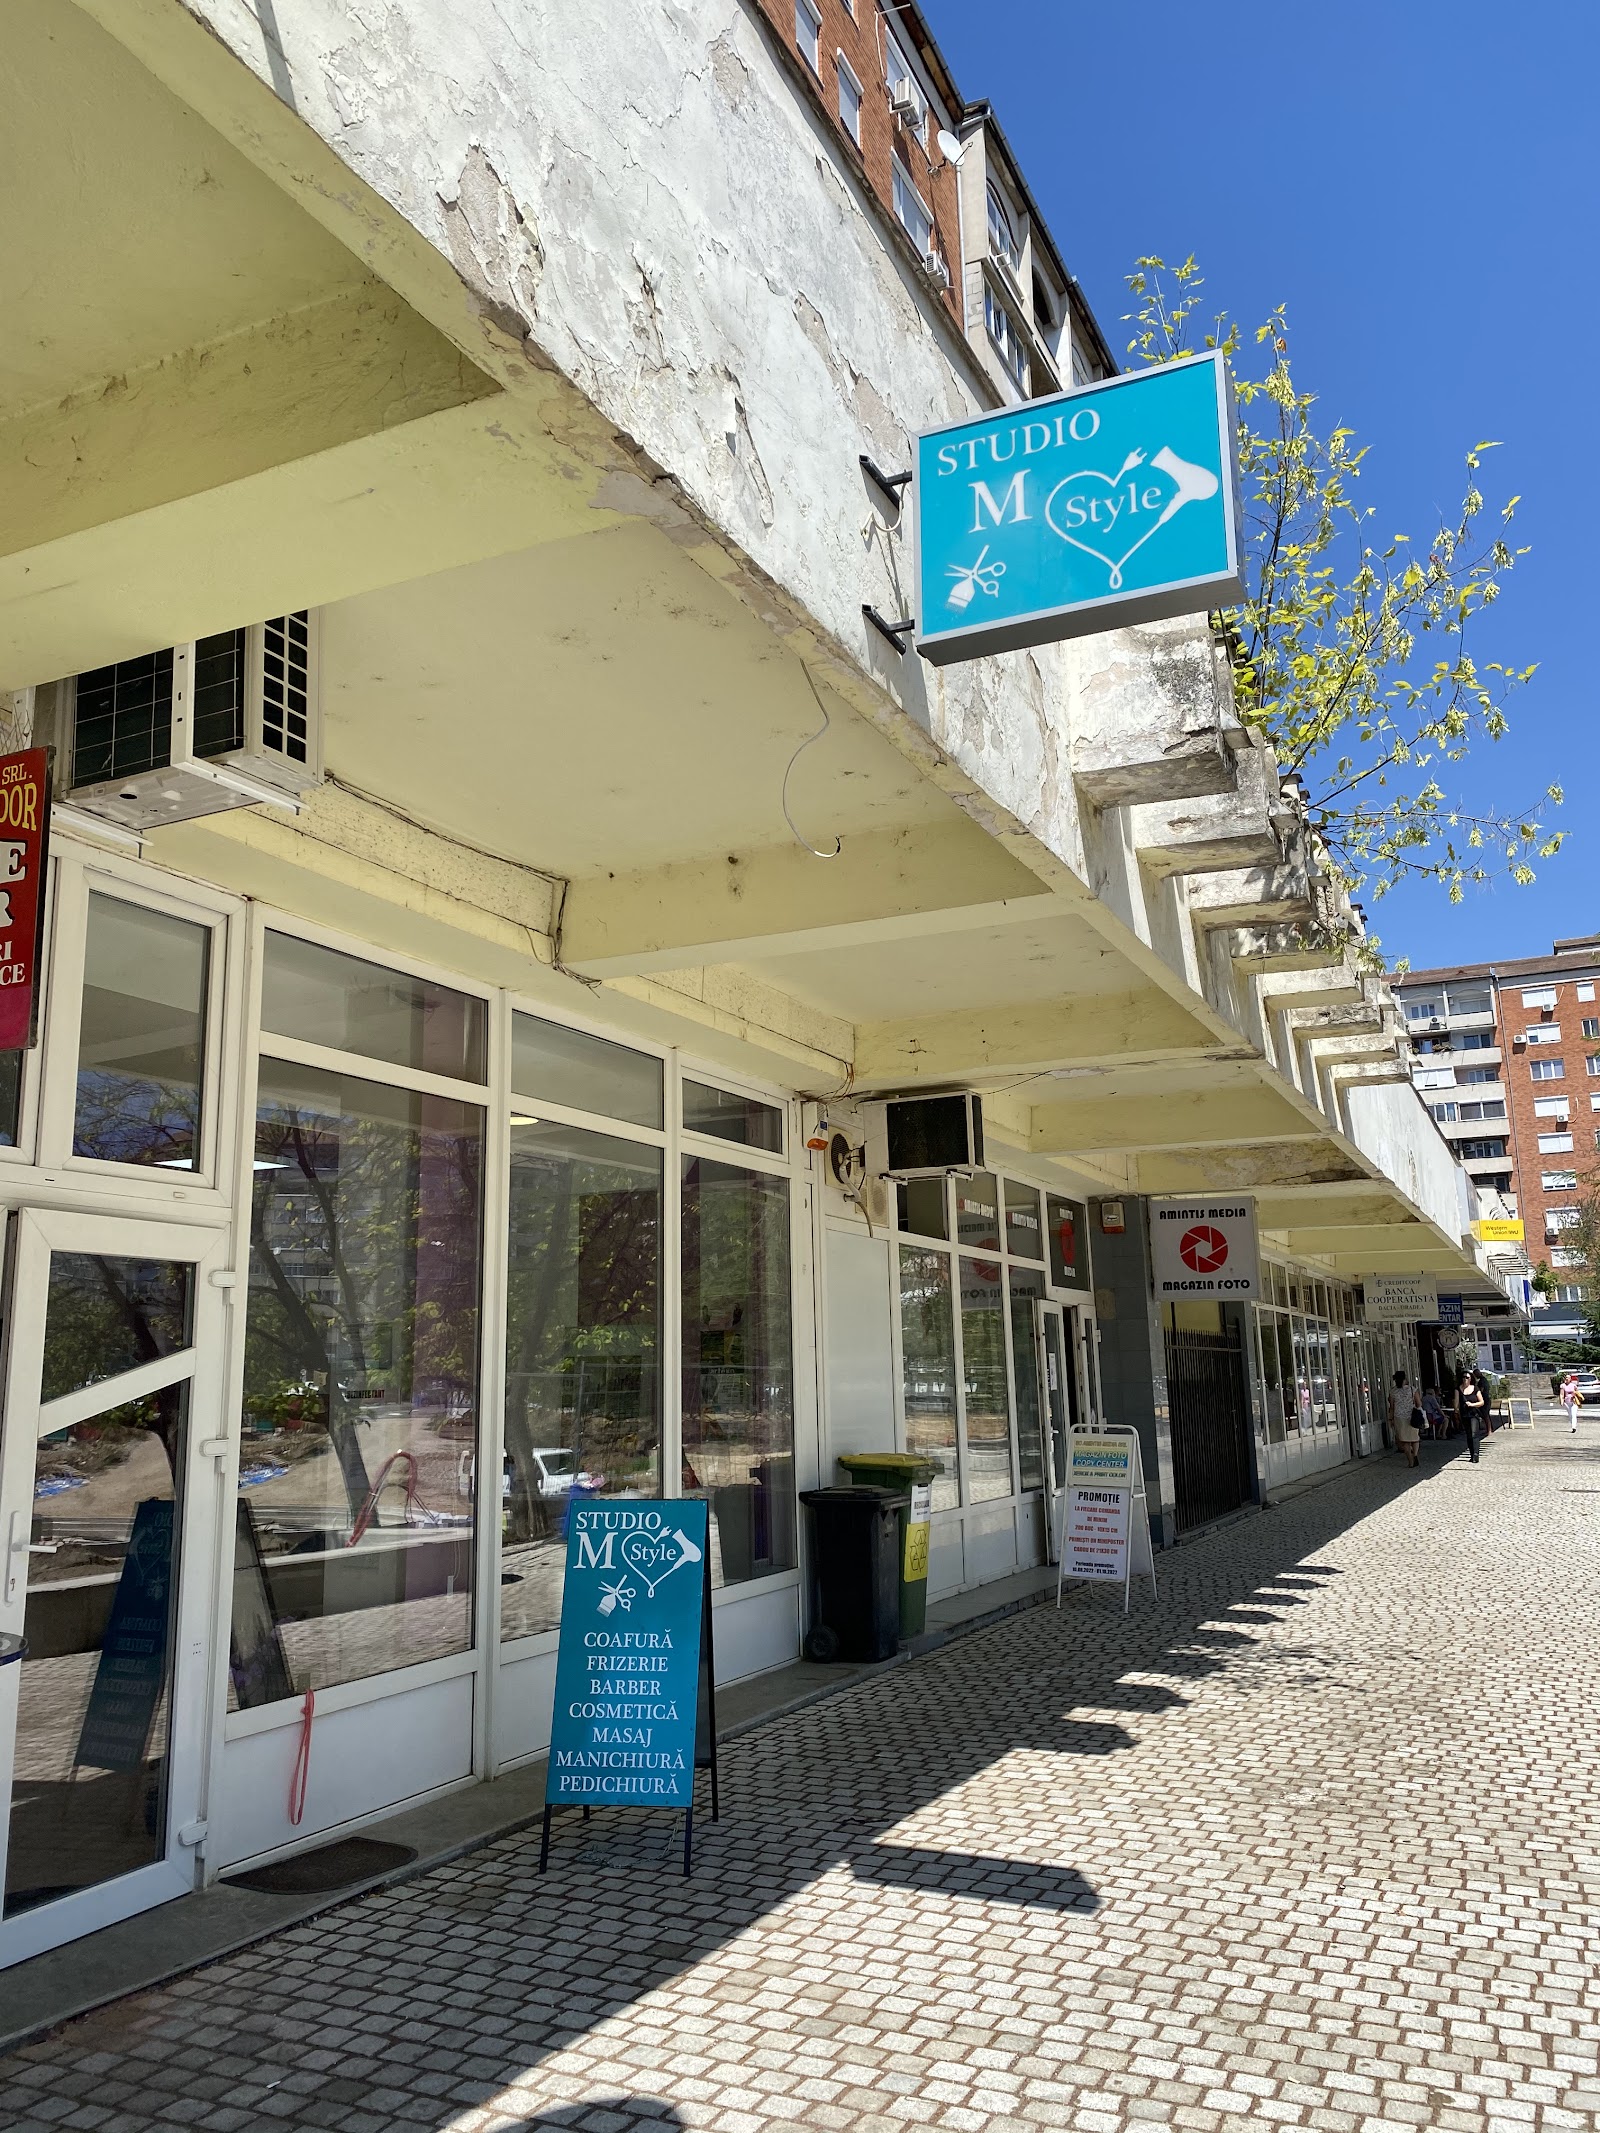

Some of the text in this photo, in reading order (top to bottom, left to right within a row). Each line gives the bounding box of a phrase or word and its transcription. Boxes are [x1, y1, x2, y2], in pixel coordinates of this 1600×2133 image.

[938, 409, 1101, 477] STUDIO
[968, 469, 1162, 534] M Style
[1159, 1208, 1246, 1220] AMINTIS MEDIA
[1162, 1279, 1250, 1291] MAGAZIN FOTO
[1385, 1287, 1415, 1295] BANCA
[1367, 1293, 1435, 1304] COOPERATISTĂ
[1074, 1450, 1127, 1459] MAGAZIN FOTO
[1076, 1459, 1125, 1468] COPY CENTER
[1078, 1491, 1120, 1505] PROMOȚIE
[575, 1511, 662, 1530] STUDIO
[573, 1532, 677, 1569] M Style
[583, 1628, 673, 1649] COAFURĂ
[586, 1655, 669, 1672] FRIZERIE
[589, 1679, 661, 1696] BARBER
[569, 1700, 679, 1720] COSMETICĂ
[592, 1727, 652, 1748] MASAJ
[556, 1749, 685, 1770] MANICHIURĂ
[559, 1773, 679, 1794] PEDICHIURĂ
